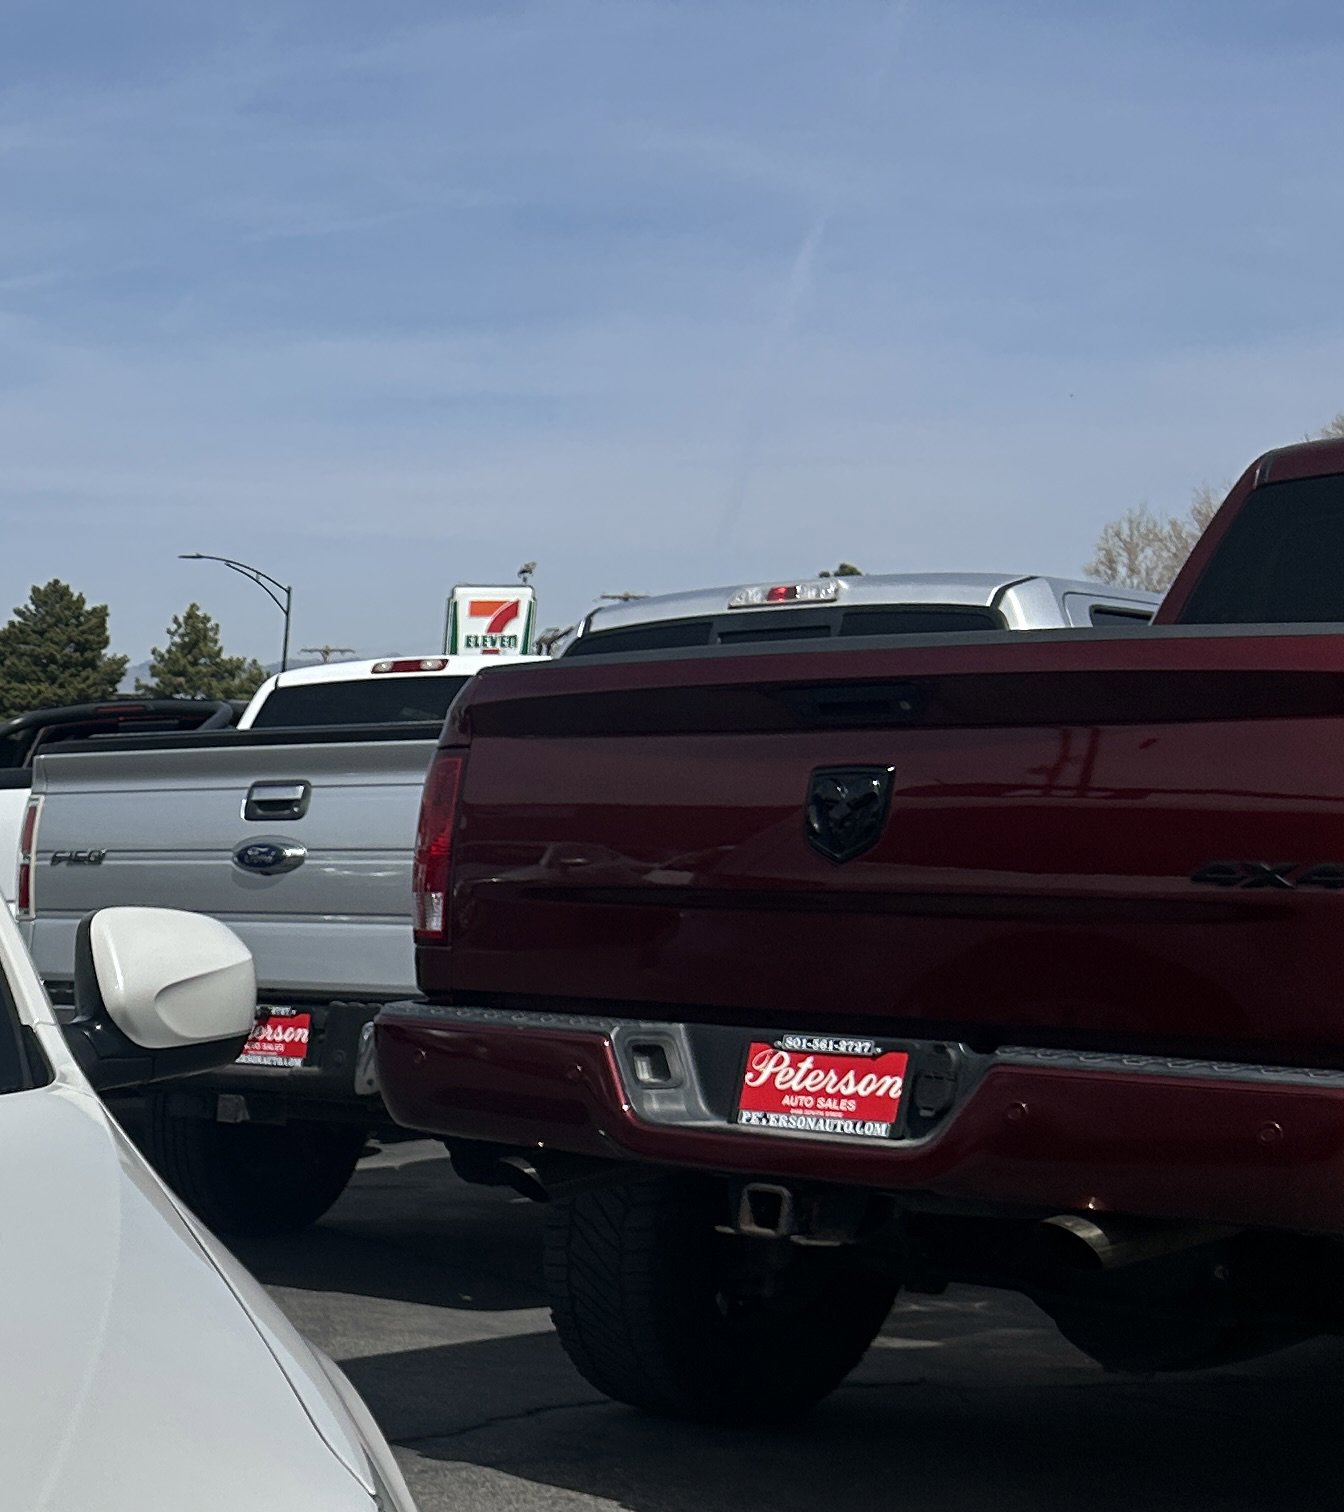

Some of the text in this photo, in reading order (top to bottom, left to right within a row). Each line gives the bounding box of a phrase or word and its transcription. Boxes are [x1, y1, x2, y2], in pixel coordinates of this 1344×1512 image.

[468, 600, 519, 654] 7
[745, 1048, 903, 1099] Peterson
[781, 1094, 857, 1112] AUTO SALES
